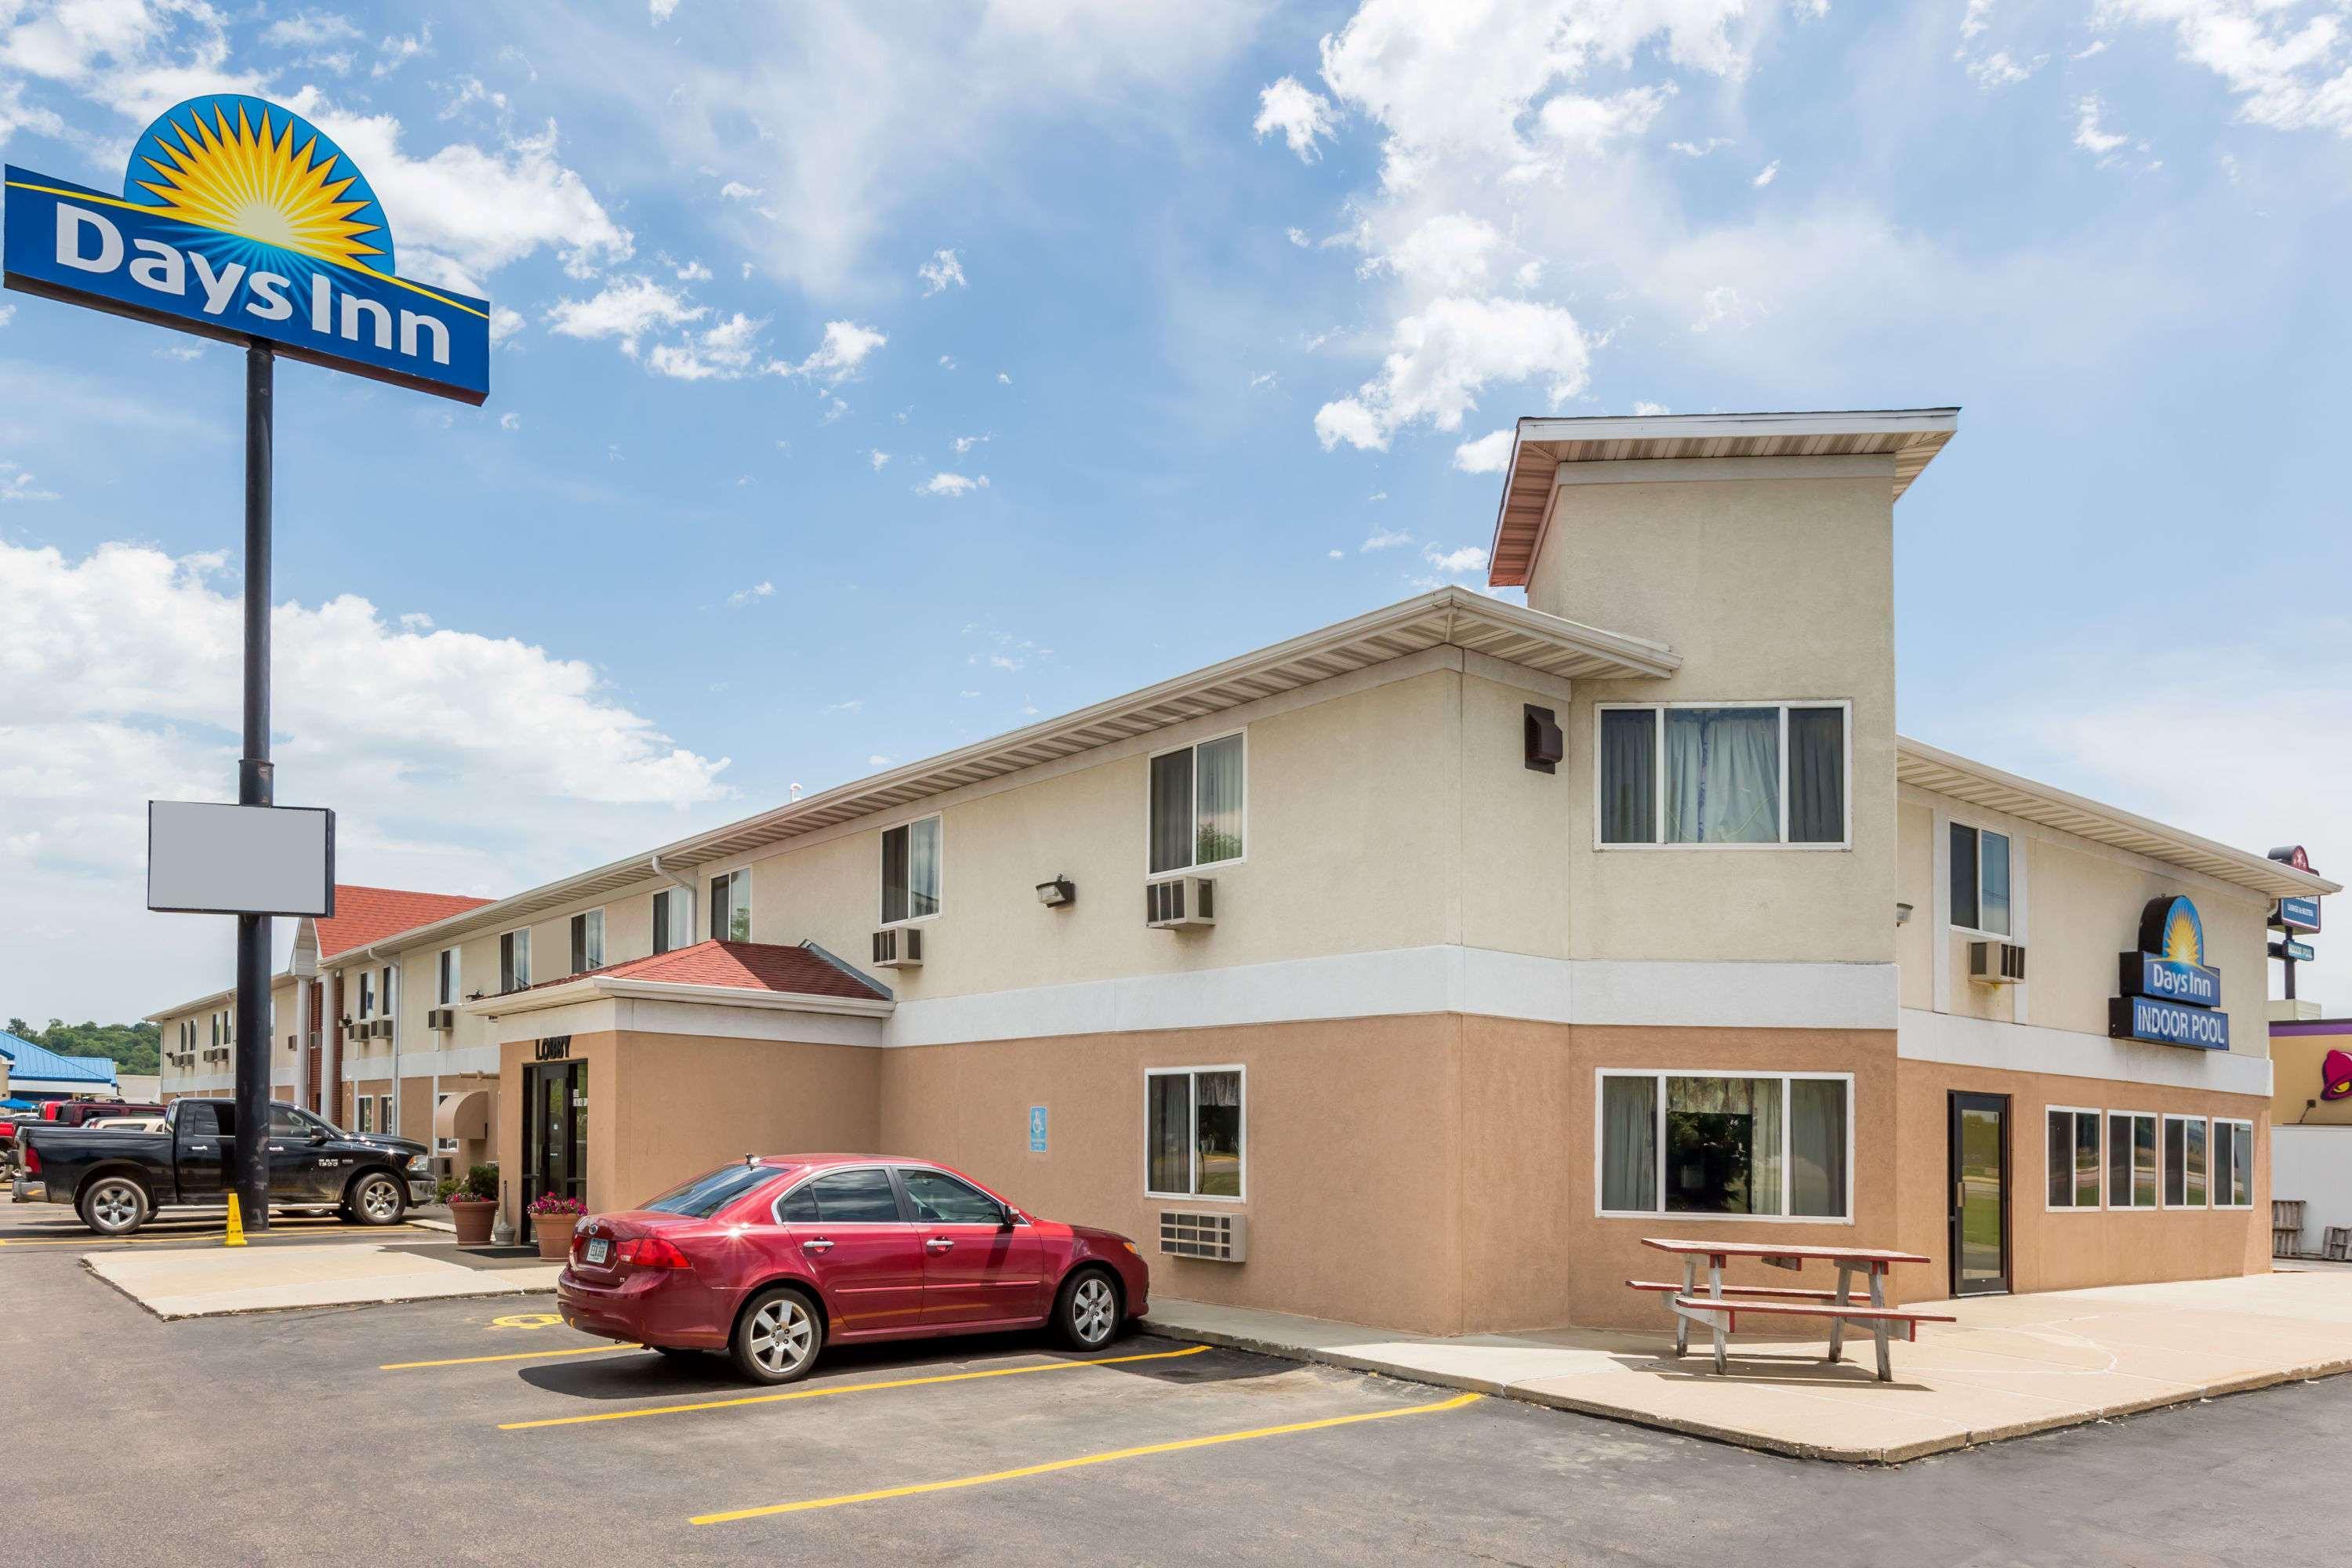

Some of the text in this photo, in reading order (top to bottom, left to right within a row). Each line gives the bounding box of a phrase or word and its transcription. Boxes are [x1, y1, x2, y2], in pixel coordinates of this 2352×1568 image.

[56, 201, 450, 365] Days Inn
[2153, 964, 2211, 997] Days Inn
[2137, 1004, 2225, 1044] INDOOR POOL
[535, 1035, 572, 1061] LOBBY
